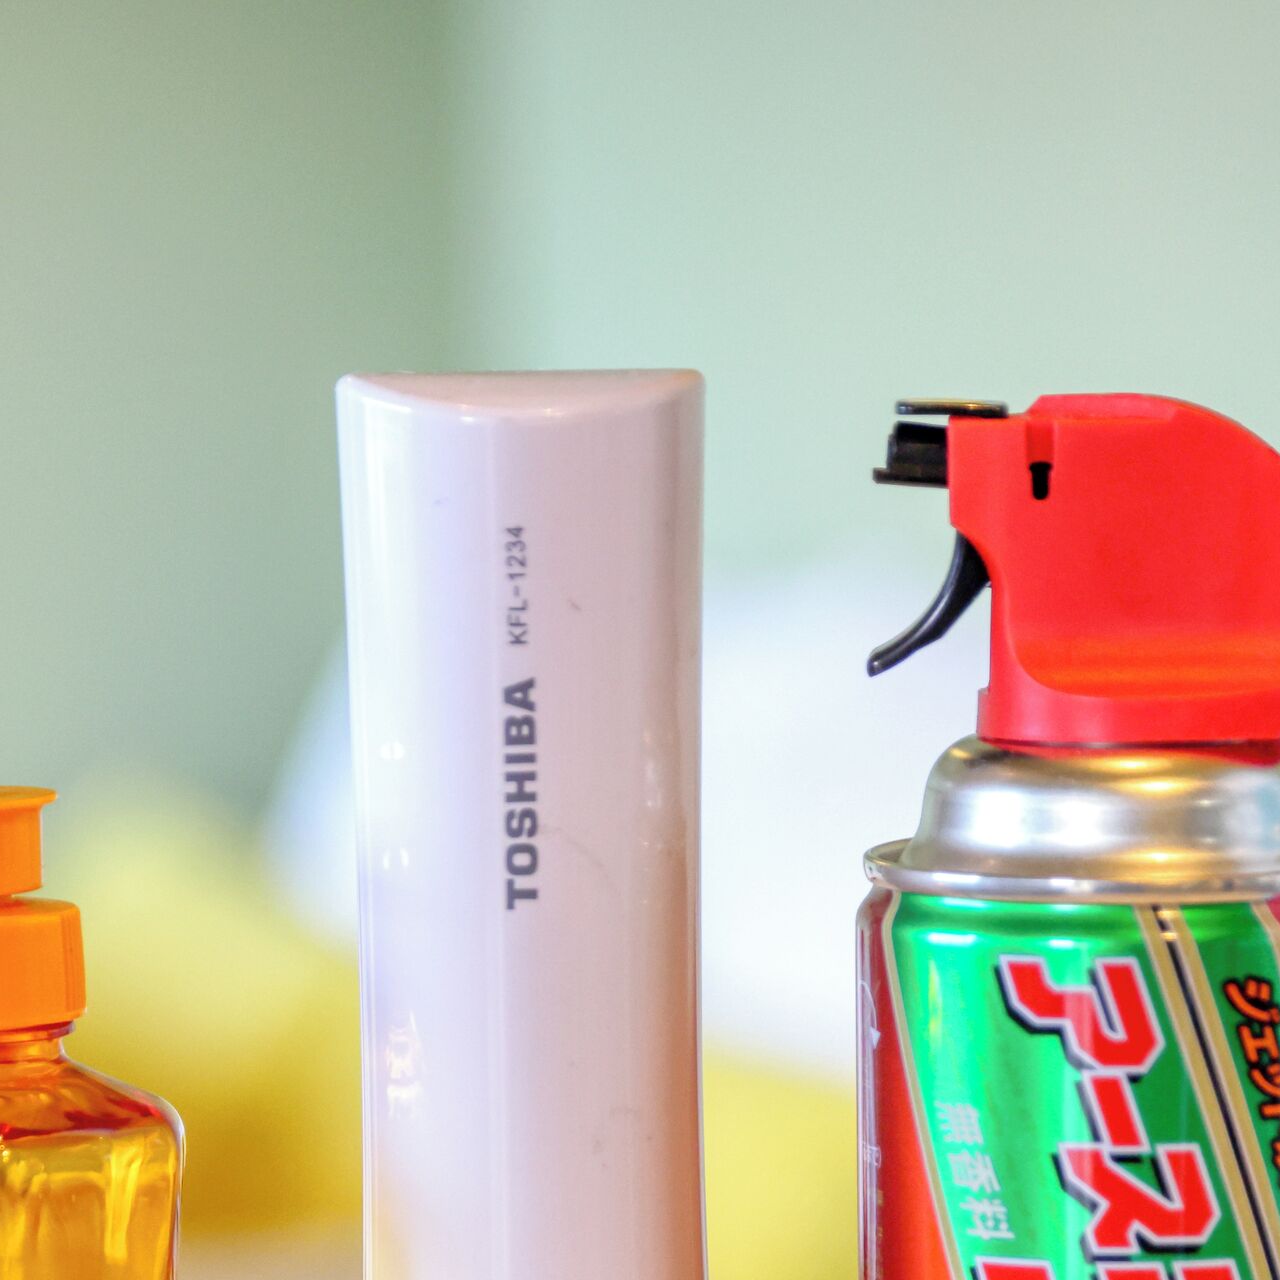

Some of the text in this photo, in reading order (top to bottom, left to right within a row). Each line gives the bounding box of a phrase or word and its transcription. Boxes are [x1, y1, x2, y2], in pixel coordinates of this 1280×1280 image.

[504, 526, 538, 909] TOSHIBA KFL-1234
[935, 1100, 1016, 1241] 無香料
